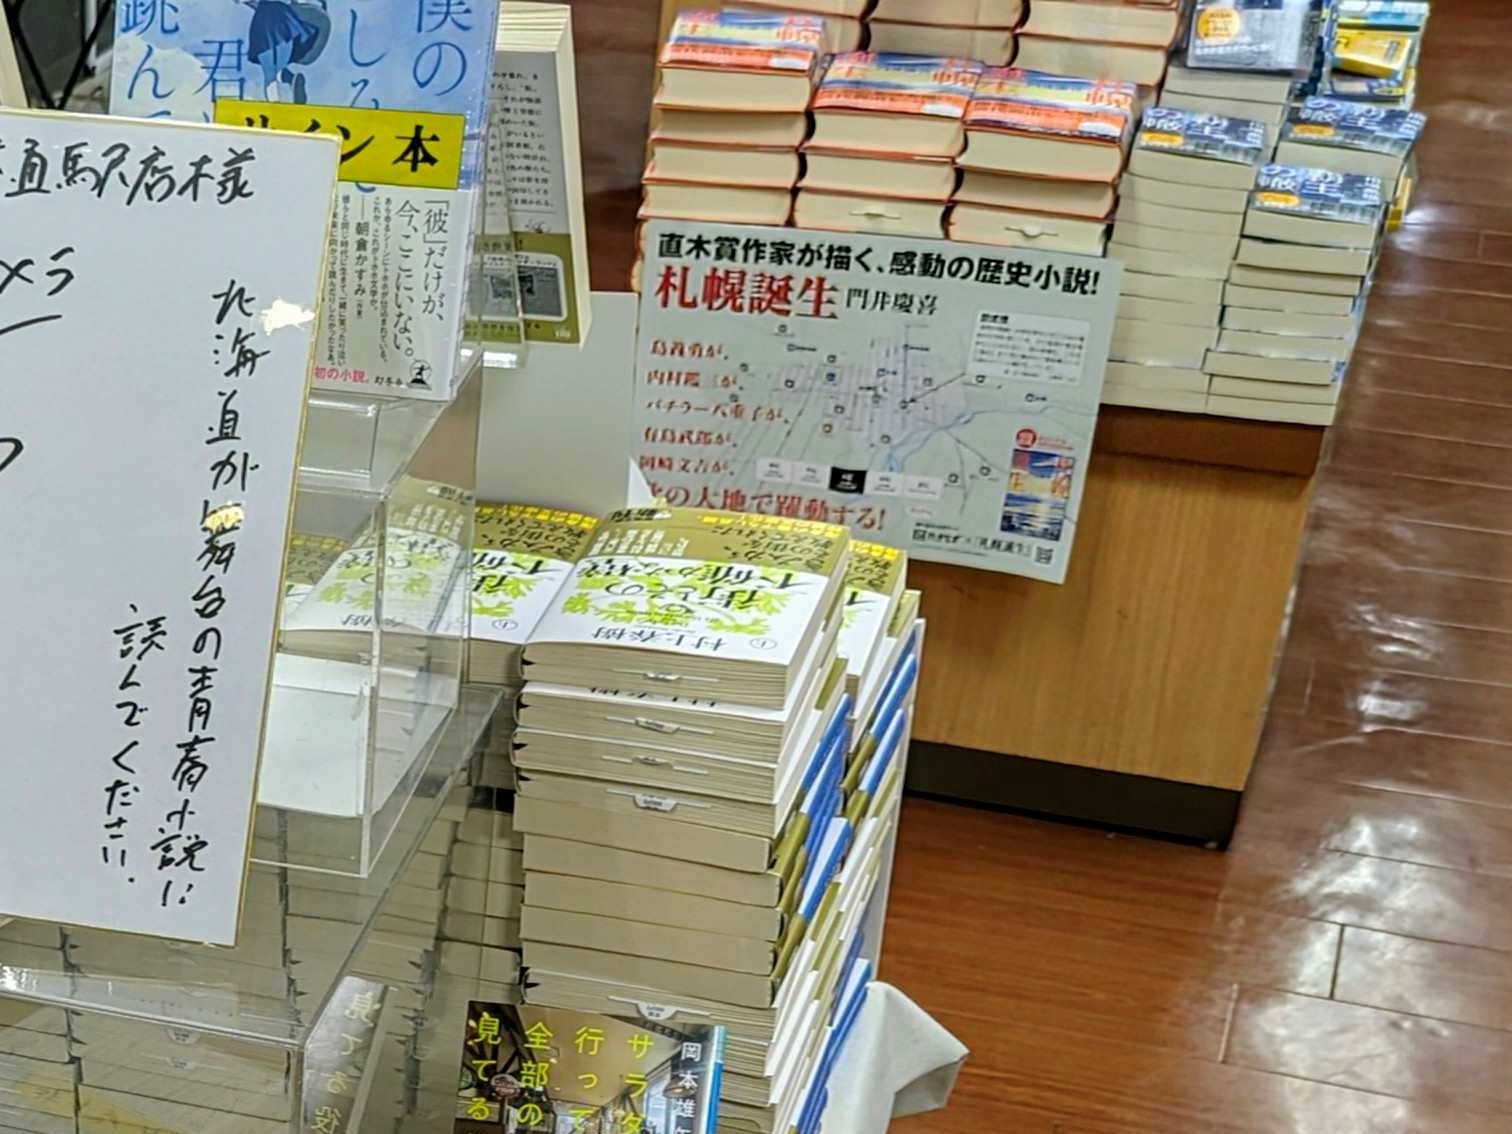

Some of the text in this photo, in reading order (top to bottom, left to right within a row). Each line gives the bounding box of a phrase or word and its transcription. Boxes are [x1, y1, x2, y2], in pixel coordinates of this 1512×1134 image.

[354, 221, 370, 297] 朝倉かすみ
[393, 199, 421, 358] 今、ここにいない。
[654, 264, 838, 320] 札幌誕生
[591, 625, 727, 652] 村上春樹
